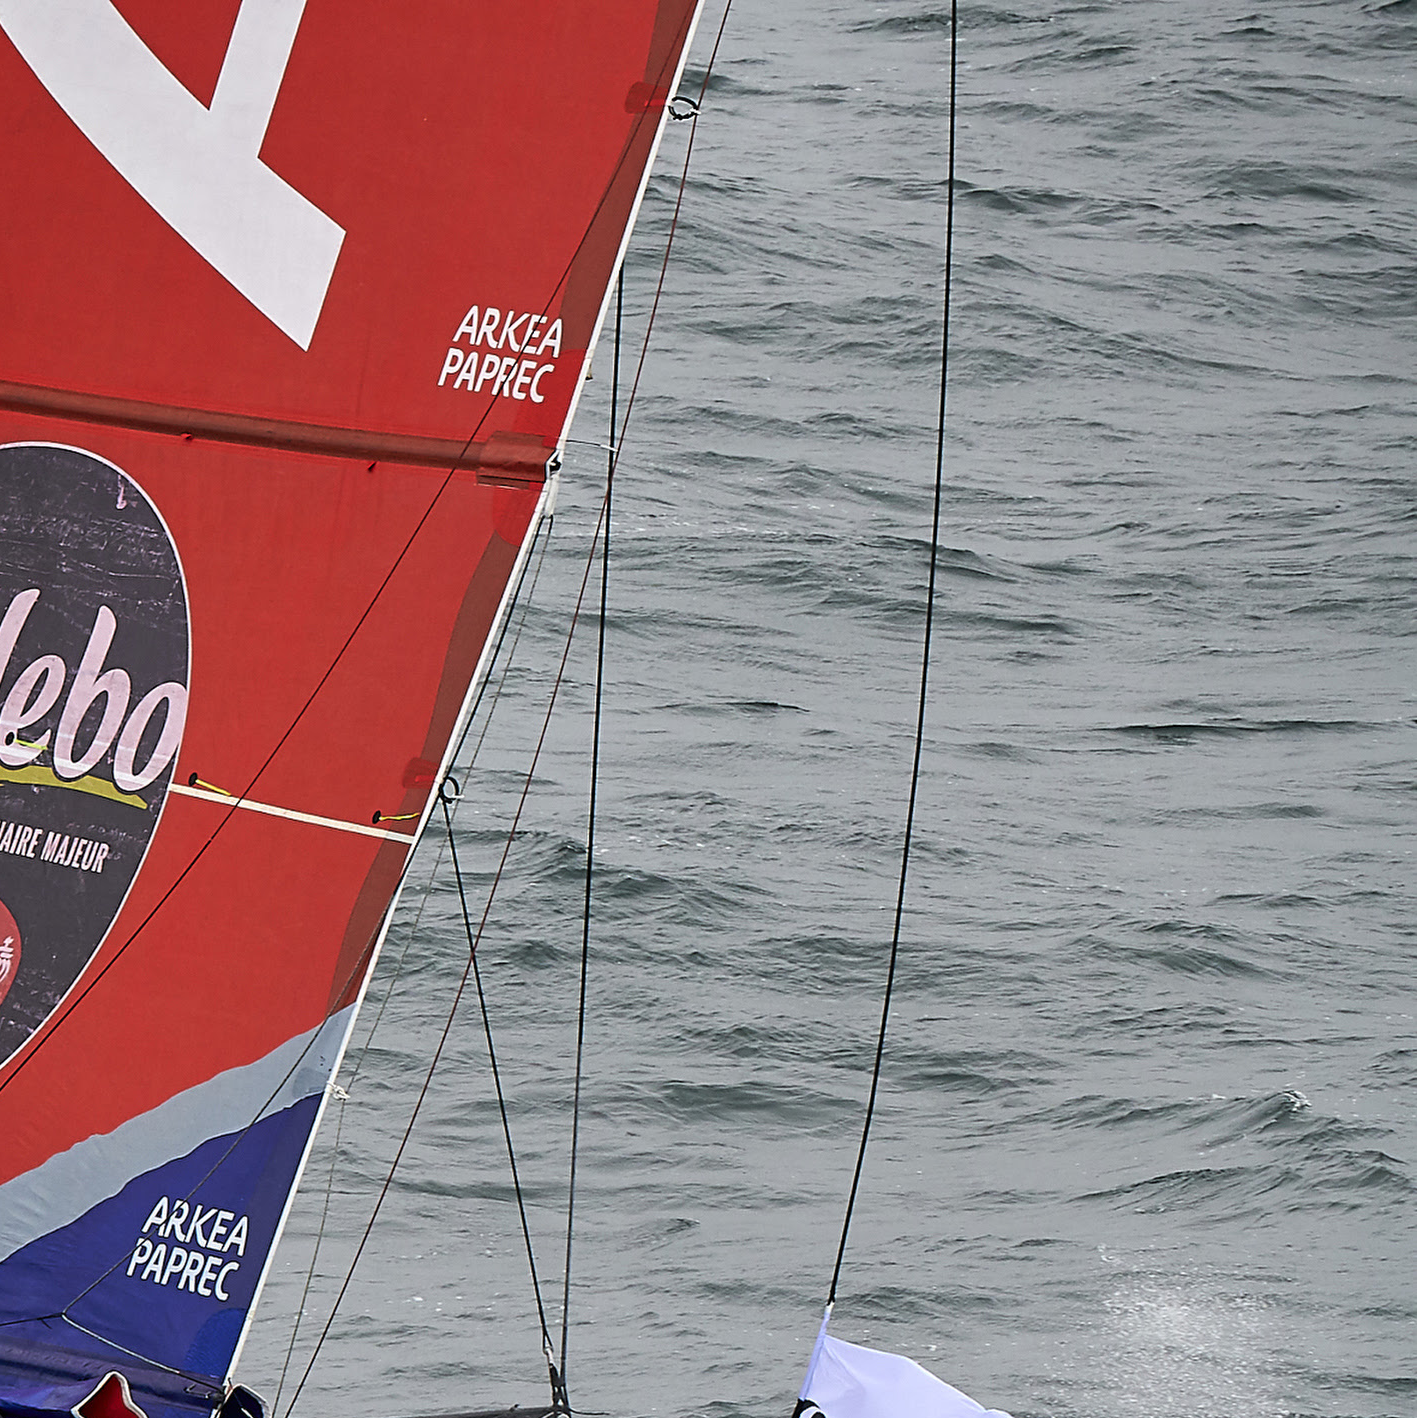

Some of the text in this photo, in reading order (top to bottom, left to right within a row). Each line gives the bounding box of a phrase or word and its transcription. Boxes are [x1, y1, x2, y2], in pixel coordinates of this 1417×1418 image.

[452, 304, 563, 359] ARKEA
[437, 347, 555, 403] PAPREC
[40, 830, 110, 874] MAJEUR
[141, 1195, 249, 1257] ARKEA
[126, 1237, 240, 1301] PAPREC
